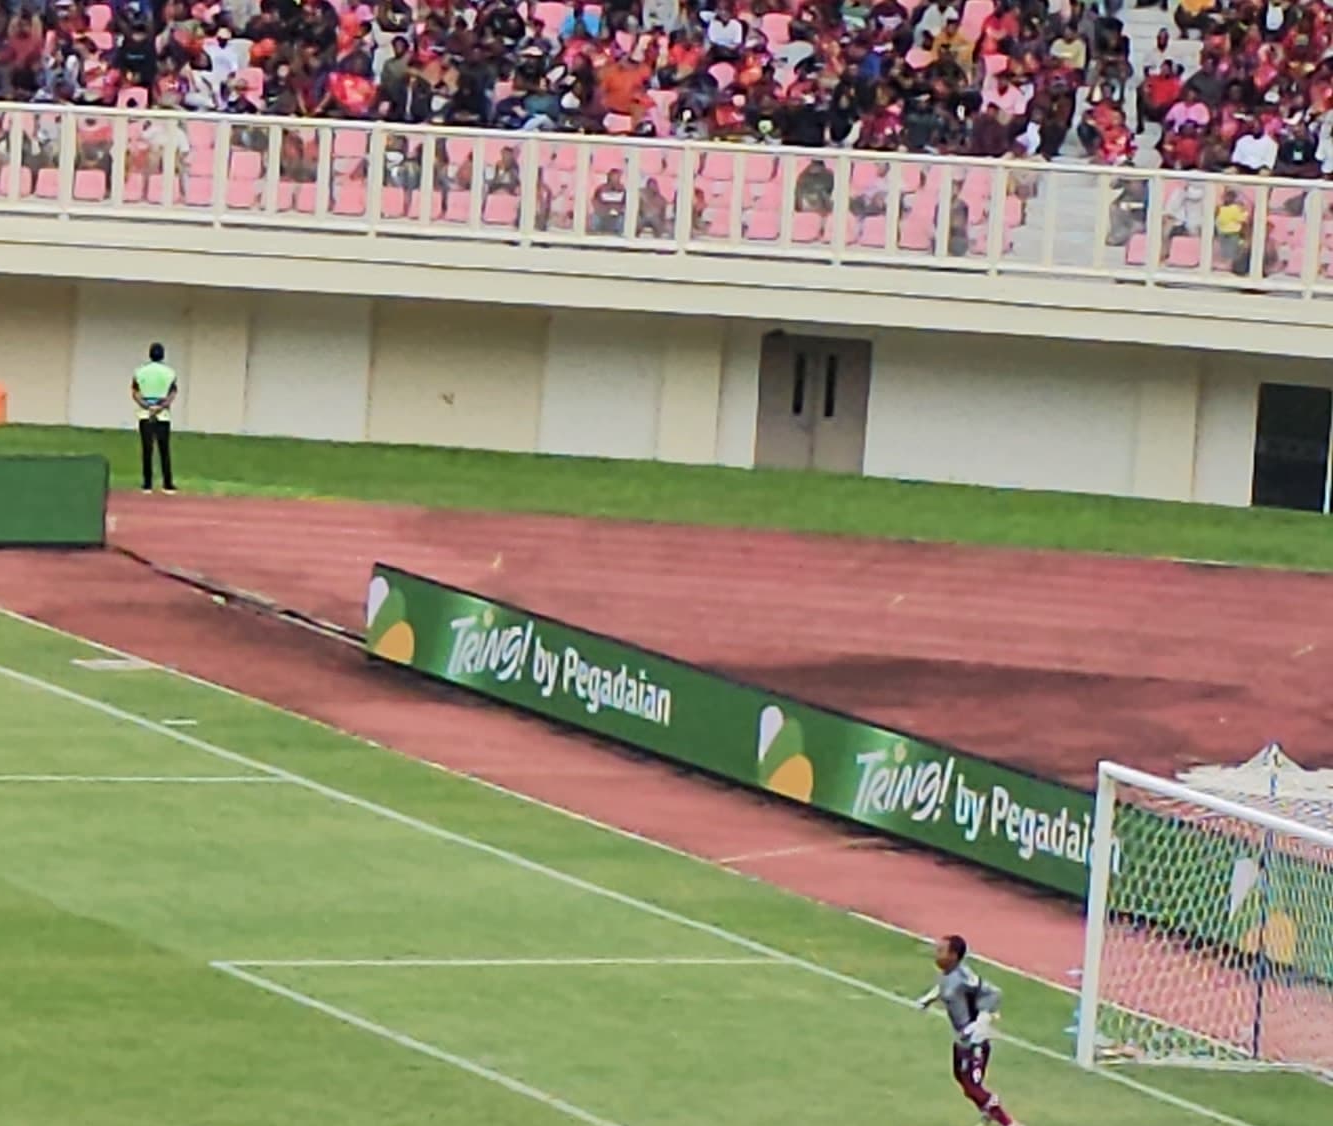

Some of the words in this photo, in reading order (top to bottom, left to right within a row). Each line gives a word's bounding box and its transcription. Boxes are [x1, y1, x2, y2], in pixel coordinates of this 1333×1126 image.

[533, 636, 560, 698] by
[562, 646, 672, 727] Pegadaian
[954, 773, 986, 842] by
